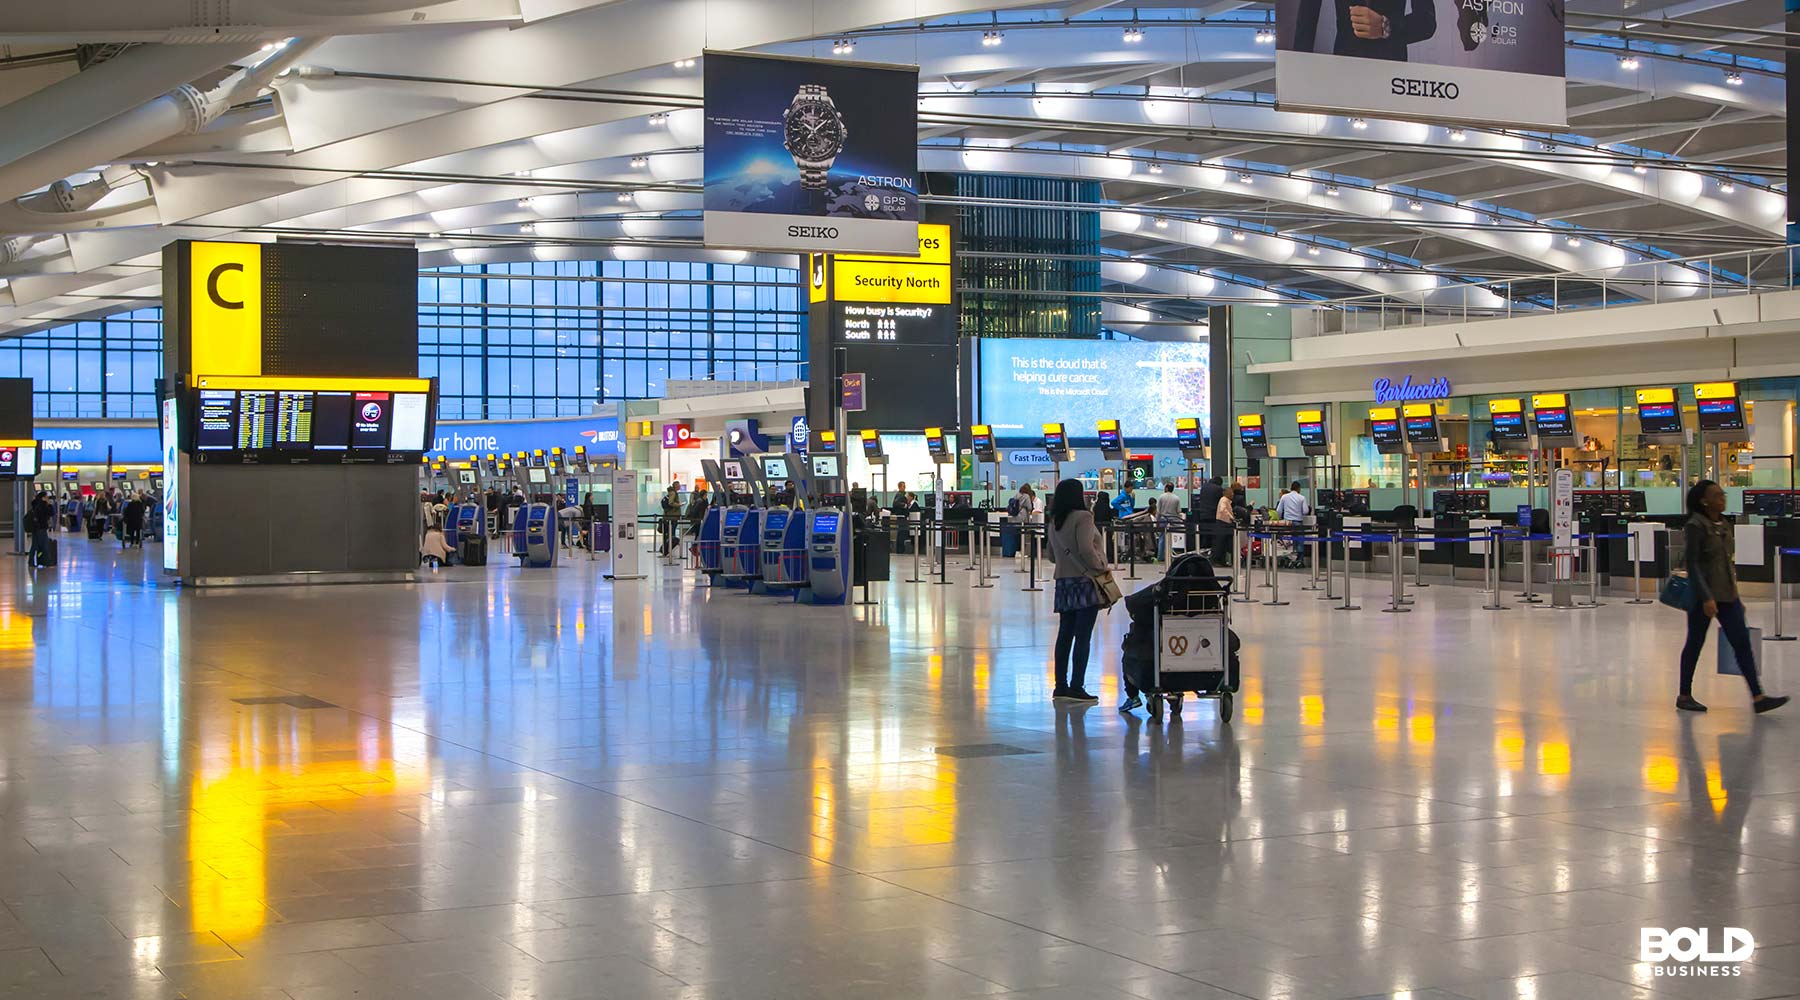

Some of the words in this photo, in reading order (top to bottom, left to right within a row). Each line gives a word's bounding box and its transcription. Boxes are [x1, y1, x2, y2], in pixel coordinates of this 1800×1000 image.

[1462, 0, 1524, 16] ASTRON
[1492, 26, 1517, 37] GPS
[1492, 38, 1517, 46] SOLAR
[1391, 78, 1458, 100] SEIKO
[858, 175, 912, 188] ASTRON
[884, 196, 906, 205] GPS
[788, 226, 838, 238] SEIKO
[207, 263, 244, 309] C
[855, 275, 903, 289] Security
[907, 277, 940, 288] North
[845, 306, 865, 315] How
[866, 306, 886, 317] busy
[887, 307, 894, 316] is
[895, 308, 932, 318] Security?
[845, 320, 870, 328] North
[845, 330, 870, 339] South
[1011, 356, 1029, 368] This
[1031, 358, 1038, 368] is
[1039, 357, 1054, 368] the
[1055, 358, 1080, 369] cloud
[1082, 358, 1099, 369] that
[1100, 359, 1107, 369] is
[1013, 370, 1046, 384] helping
[1048, 374, 1067, 383] cure
[1373, 375, 1449, 404] Carluccio's
[454, 432, 499, 451] home.
